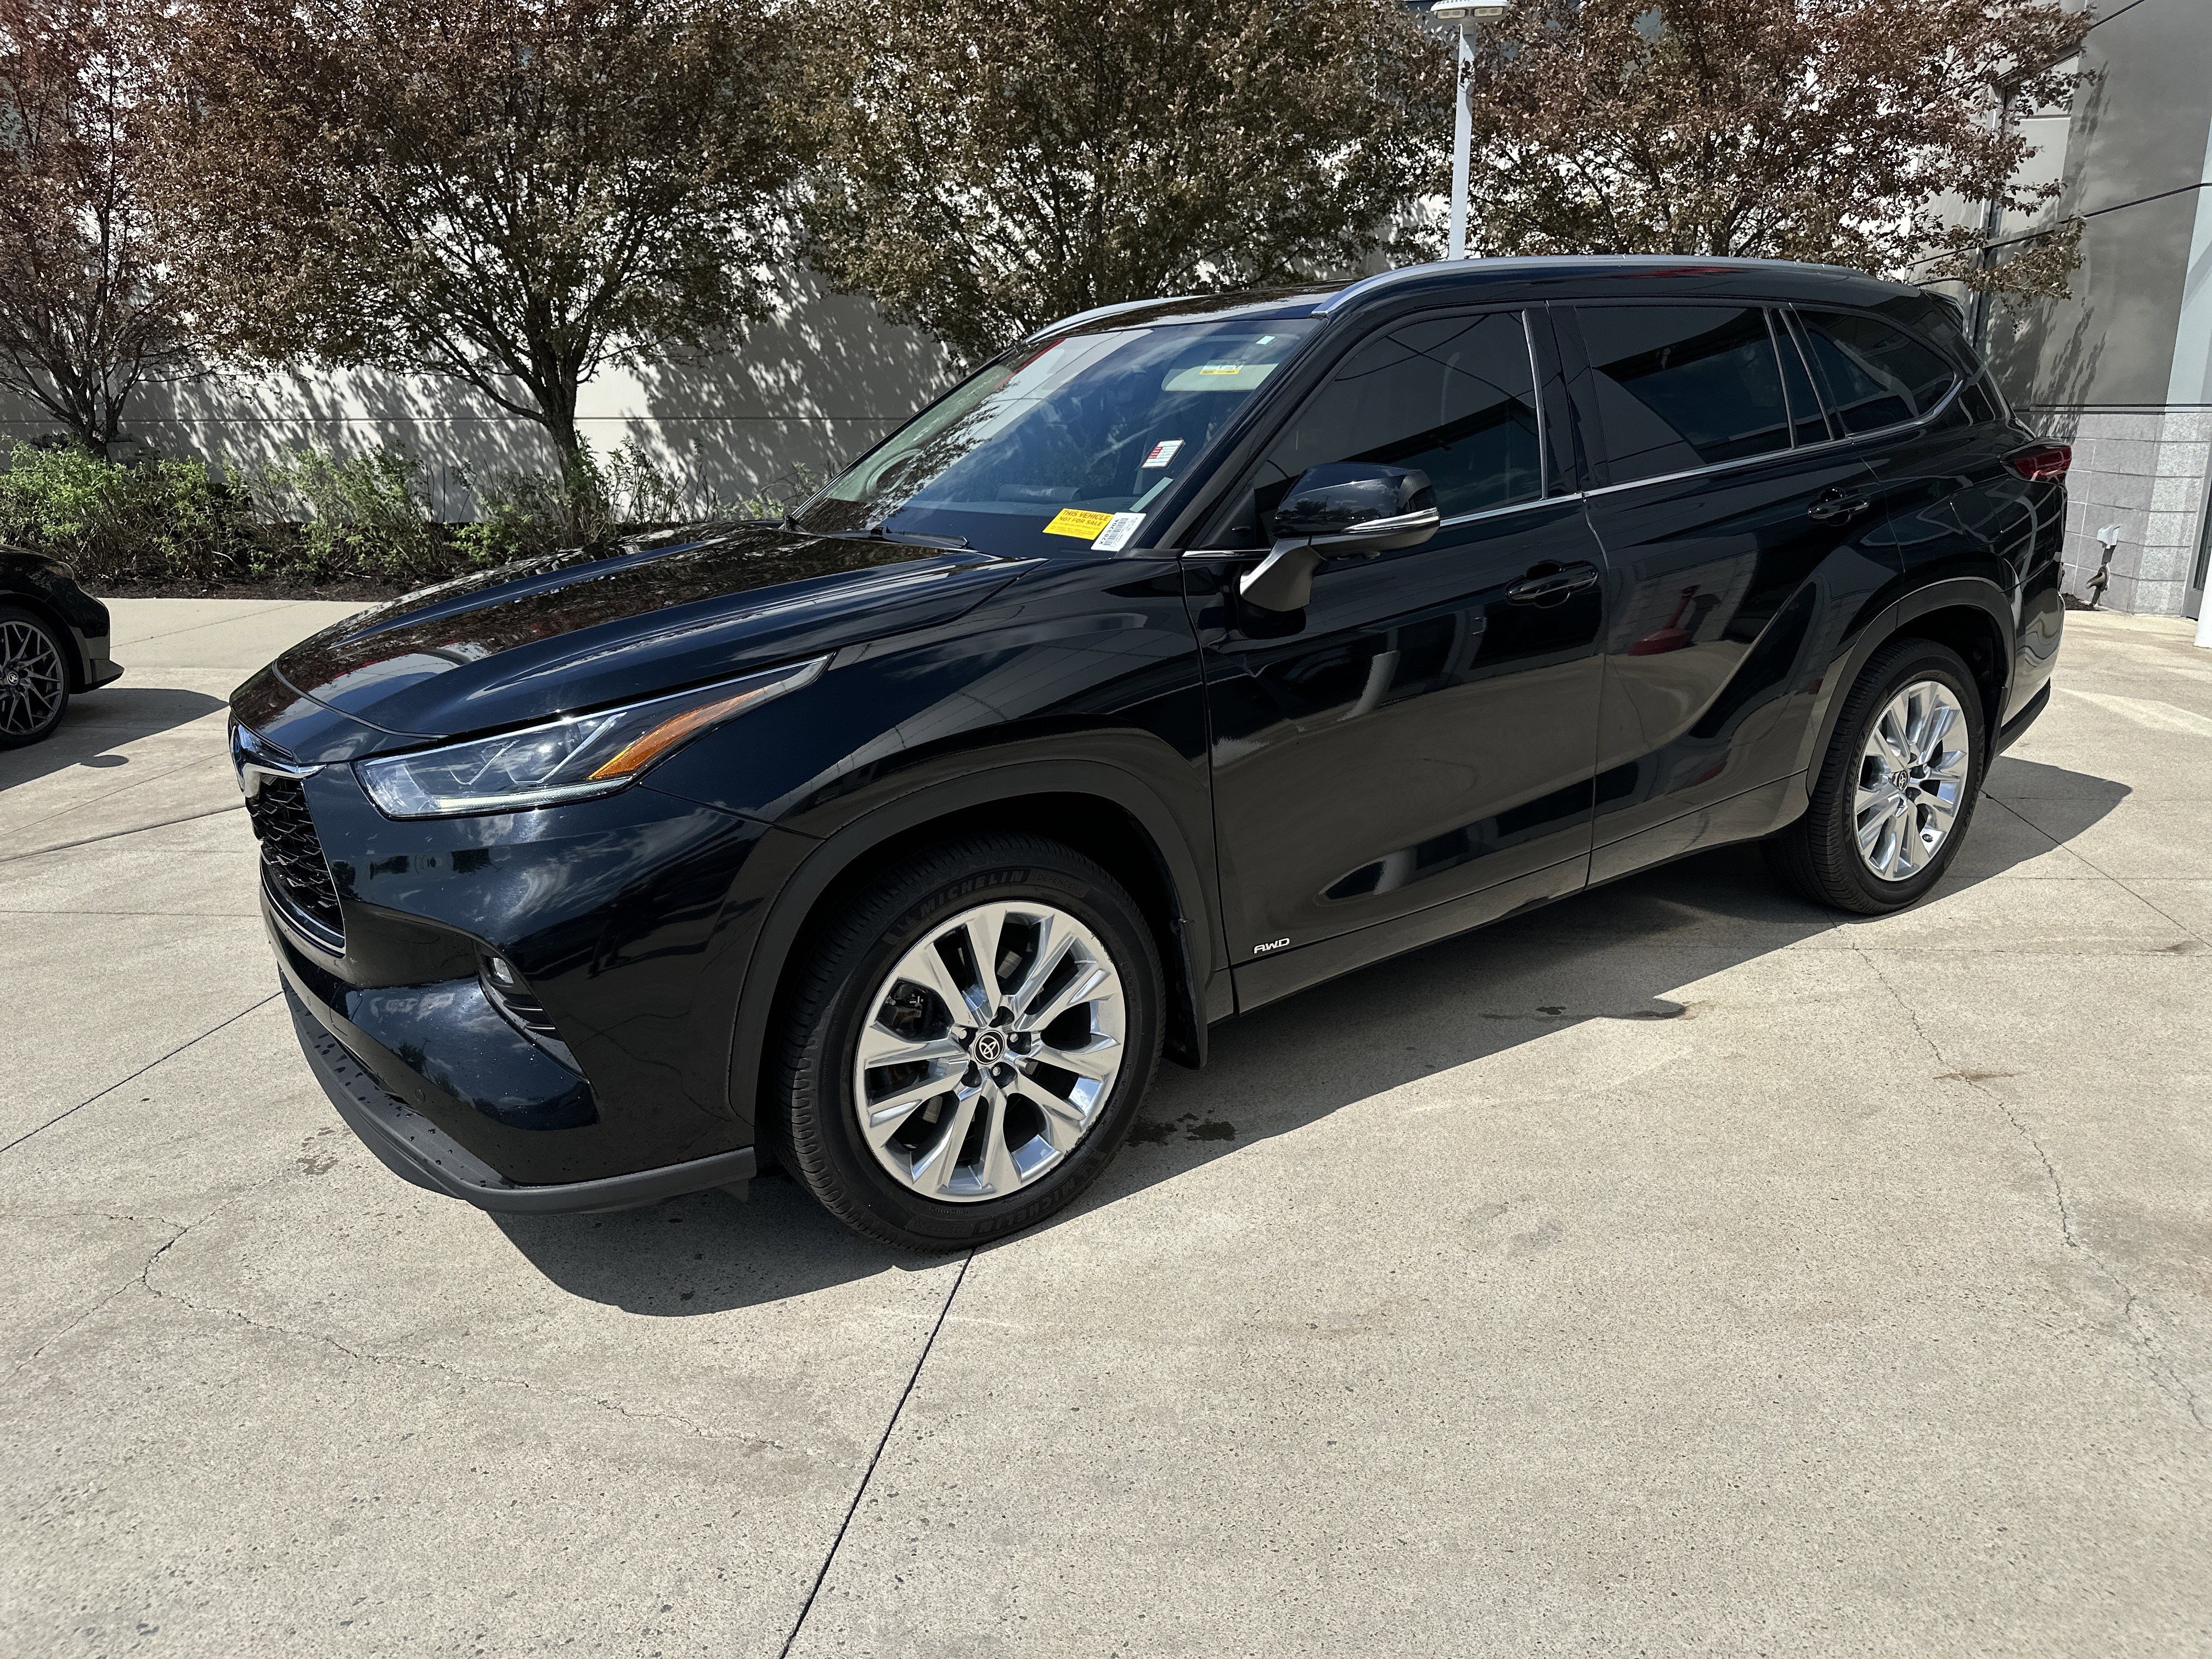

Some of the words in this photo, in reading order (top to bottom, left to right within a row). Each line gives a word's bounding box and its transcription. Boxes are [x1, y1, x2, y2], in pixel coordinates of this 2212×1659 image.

[1079, 512, 1110, 521] VEHICLE
[920, 870, 1024, 917] MICHELIN
[1037, 874, 1079, 890] DEFENDER
[1254, 938, 1290, 953] AWD
[979, 1178, 1075, 1233] MICHELIN
